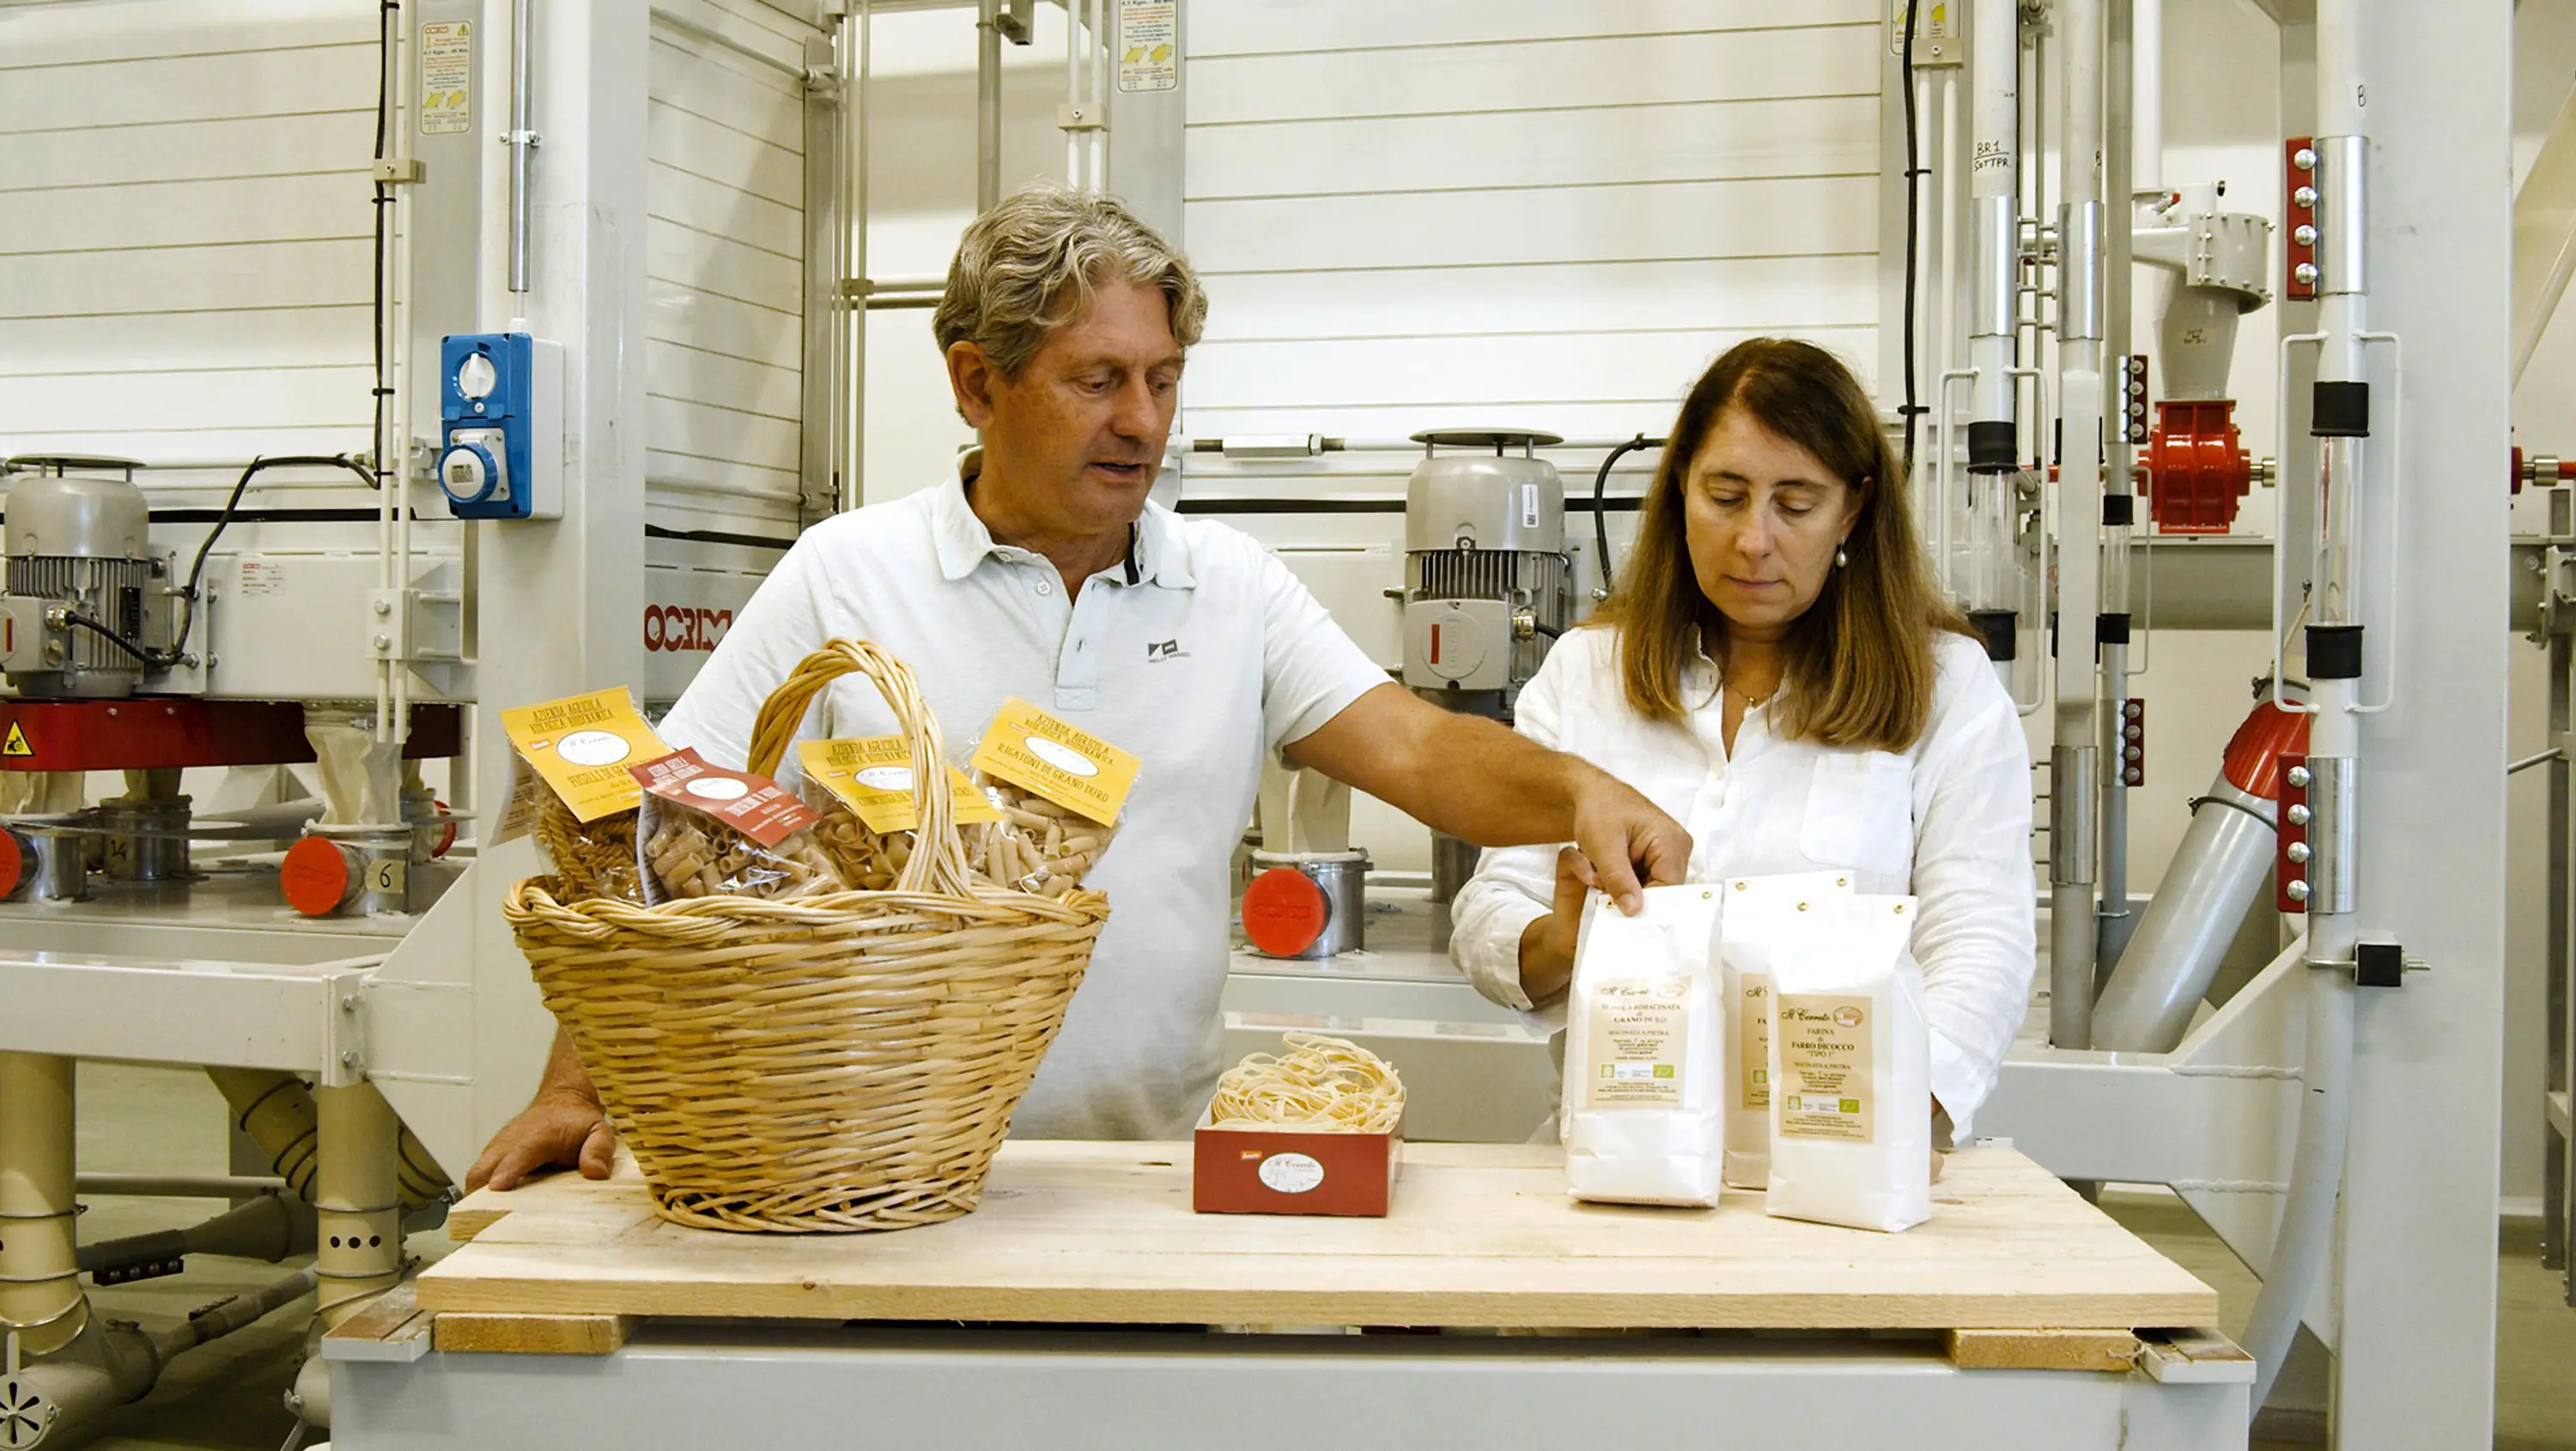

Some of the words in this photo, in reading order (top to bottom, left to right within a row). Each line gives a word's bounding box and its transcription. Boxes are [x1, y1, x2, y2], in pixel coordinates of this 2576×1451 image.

[643, 604, 733, 653] OCRIM
[1035, 713, 1071, 738] AZIENDA
[1072, 731, 1109, 756] AGRICOLA
[996, 742, 1042, 771] RIGATONI
[1041, 763, 1053, 776] DI
[1052, 769, 1085, 792] GRANO
[1084, 785, 1110, 804] DURO
[379, 862, 392, 889] 6
